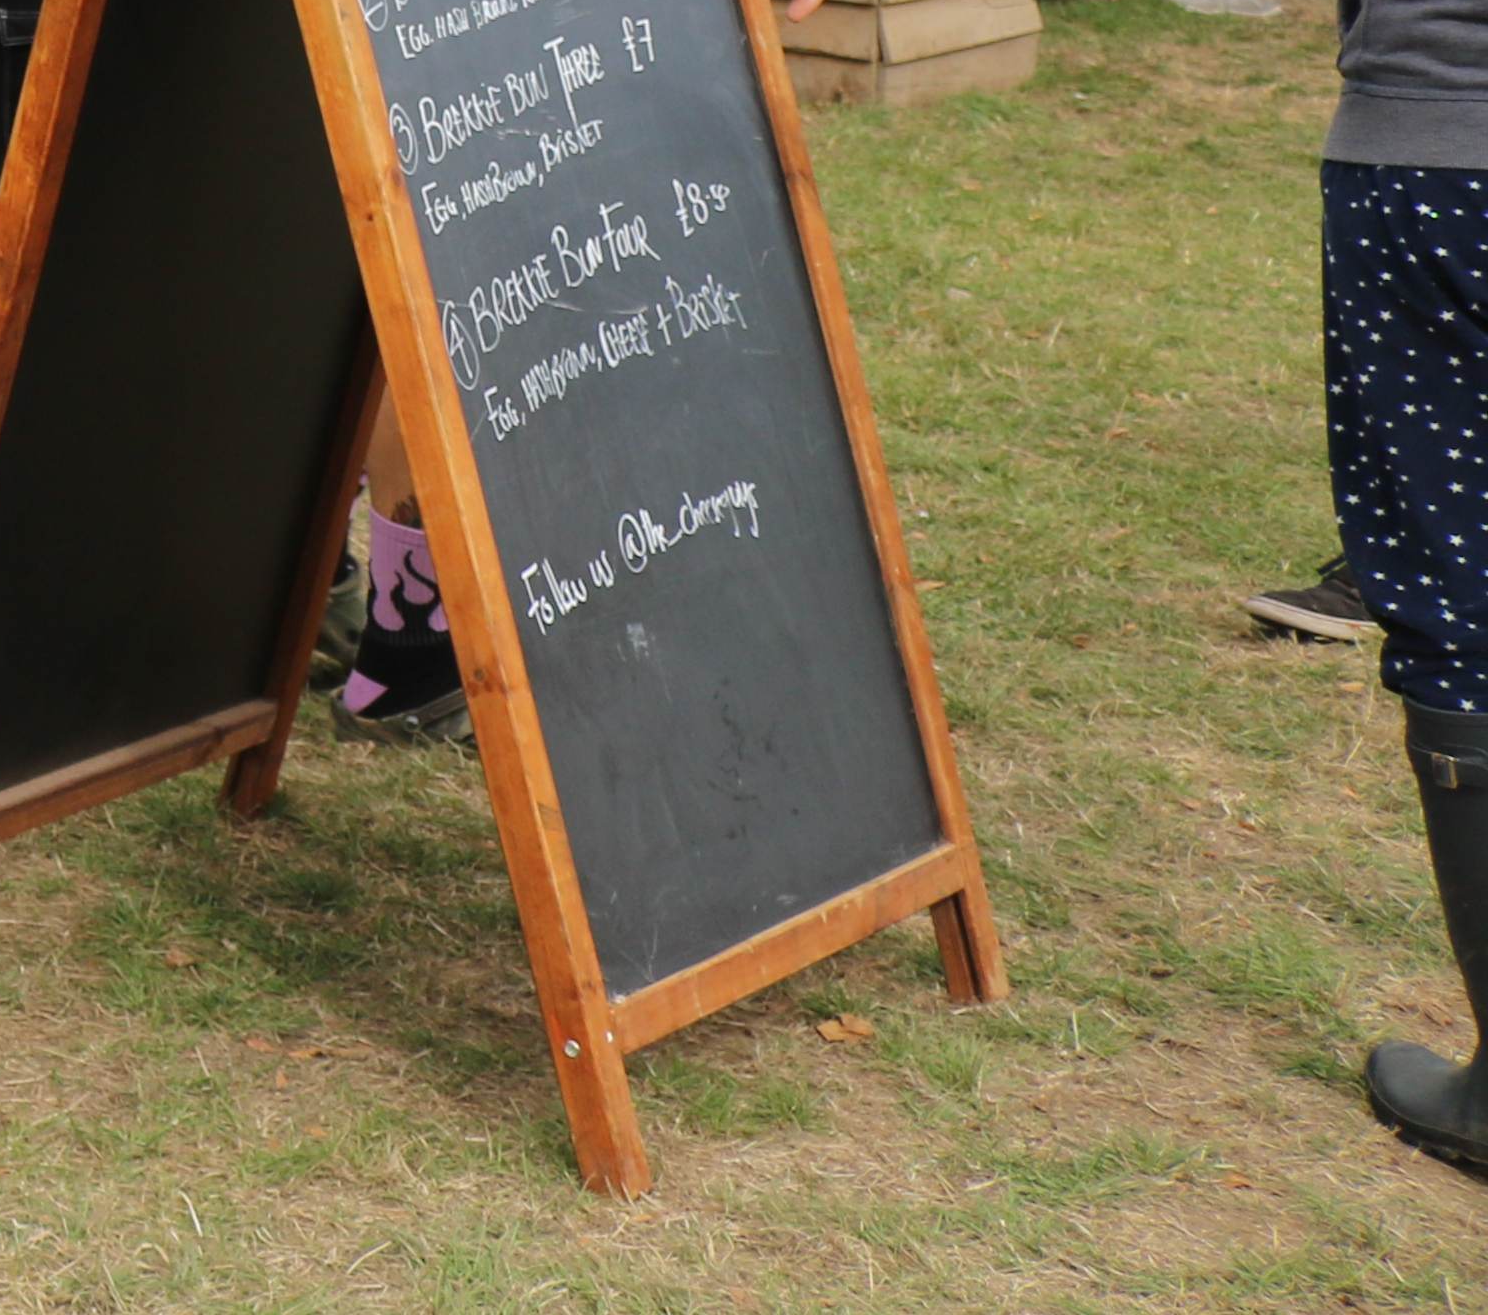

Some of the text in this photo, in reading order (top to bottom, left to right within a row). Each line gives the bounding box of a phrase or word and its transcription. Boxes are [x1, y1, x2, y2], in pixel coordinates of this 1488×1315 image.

[434, 6, 470, 40] HASH
[503, 62, 550, 117] BUN
[542, 35, 605, 126] THREE
[620, 15, 656, 73] £7
[549, 224, 605, 289] BUN
[597, 200, 662, 273] FOUR
[671, 177, 732, 239] £8.50
[597, 313, 655, 369] CHEESE
[520, 556, 588, 637] Follow
[587, 548, 616, 589] us
